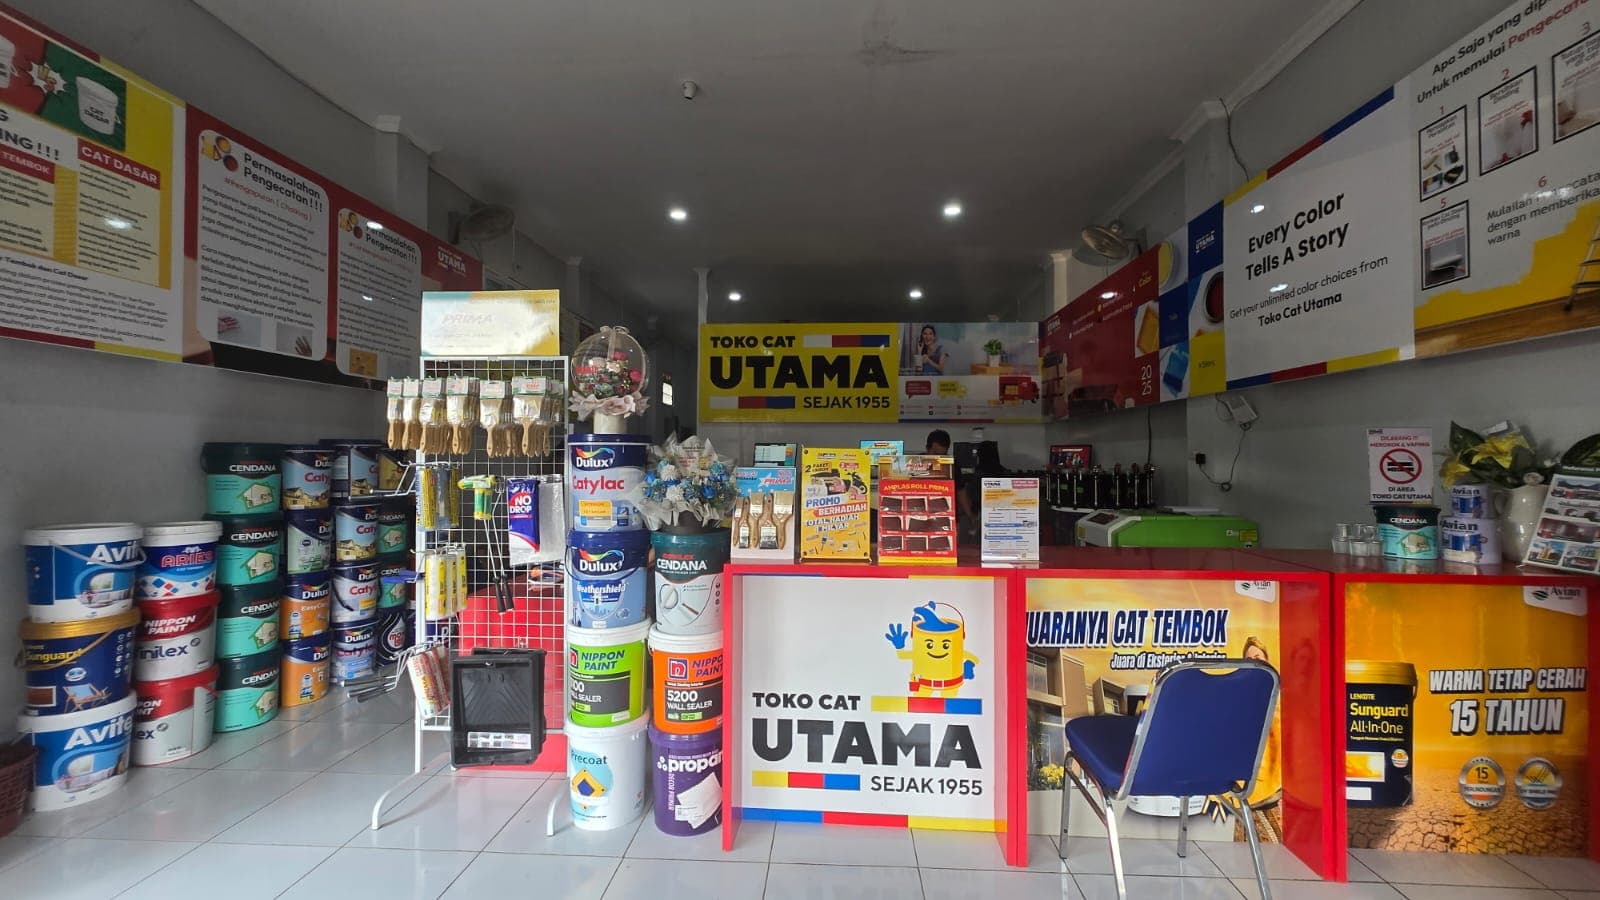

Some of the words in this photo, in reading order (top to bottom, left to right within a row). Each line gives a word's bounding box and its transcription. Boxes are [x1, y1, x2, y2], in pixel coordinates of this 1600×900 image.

[1582, 21, 1591, 36] 3
[1432, 54, 1456, 76] Apa
[1457, 37, 1486, 60] Saja
[1488, 13, 1522, 41] yang
[1417, 77, 1451, 104] Untuk
[1451, 42, 1507, 84] memulai
[1502, 68, 1510, 81] 2
[1439, 105, 1445, 116] 1
[3, 152, 49, 174] TEMBOK
[82, 147, 111, 165] CAT
[114, 160, 158, 184] DASAR
[244, 152, 321, 199] Permasalahan
[1538, 175, 1548, 189] 6
[1440, 197, 1447, 209] 5
[1248, 221, 1291, 254] Every
[1294, 193, 1345, 230] Color
[1487, 213, 1527, 234] dengan
[1487, 229, 1520, 246] warna
[1245, 254, 1279, 281] Tells
[1283, 246, 1295, 265] A
[1299, 223, 1349, 257] Story
[438, 251, 467, 274] UTAMA
[1230, 308, 1242, 319] Get
[1243, 302, 1260, 317] your
[1260, 288, 1295, 309] unlimited
[1296, 281, 1320, 296] color
[1320, 267, 1358, 287] choices
[1359, 255, 1388, 275] from
[1258, 311, 1282, 328] Toko
[1283, 305, 1303, 319] Cat
[1304, 292, 1342, 313] Utama
[710, 336, 759, 348] TOKO
[762, 336, 796, 348] CAT
[710, 355, 889, 389] UTAMA
[1141, 364, 1152, 379] 20
[1141, 381, 1152, 396] 25
[804, 396, 852, 409] SEJAK
[856, 396, 890, 409] 1955
[229, 463, 277, 473] CENDANA
[576, 457, 610, 468] Dulux
[805, 464, 813, 473] 2
[573, 476, 625, 495] Catylac
[1452, 487, 1480, 496] Avian
[515, 496, 531, 506] NO
[806, 495, 841, 508] PROMO
[818, 503, 867, 516] BERHADIAH
[1389, 516, 1428, 525] CENDANA
[1442, 520, 1478, 531] Avian
[230, 530, 279, 542] CENDANA
[162, 550, 213, 568] ARIES
[579, 559, 618, 572] Dulux
[656, 558, 707, 571] CENDANA
[577, 582, 626, 594] Weathershield
[1551, 586, 1581, 597] Avian
[145, 615, 196, 628] NIPPON
[1113, 610, 1149, 646] CAT
[1152, 609, 1229, 646] TEMBOK
[148, 624, 188, 635] PAINT
[345, 632, 371, 643] Dulux
[581, 649, 625, 661] NIPPON
[1110, 653, 1136, 669] Juara
[1137, 653, 1146, 668] di
[584, 660, 618, 670] PAINT
[692, 656, 723, 669] NIPPO
[1429, 670, 1483, 692] WARNA
[1487, 669, 1532, 691] TETAP
[1536, 668, 1586, 690] CERAH
[579, 694, 602, 703] SEALER
[667, 690, 698, 702] 5200
[752, 692, 813, 710] TOKO
[818, 694, 861, 711] CAT
[667, 702, 686, 711] WALL
[687, 700, 712, 710] SEALER
[1350, 703, 1409, 719] Sunguard
[1450, 700, 1478, 733] 15
[1485, 699, 1564, 733] TAHUN
[752, 718, 982, 769] UTAMA
[1475, 767, 1489, 779] 15
[870, 775, 935, 794] SEJAK
[939, 778, 983, 796] 1955
